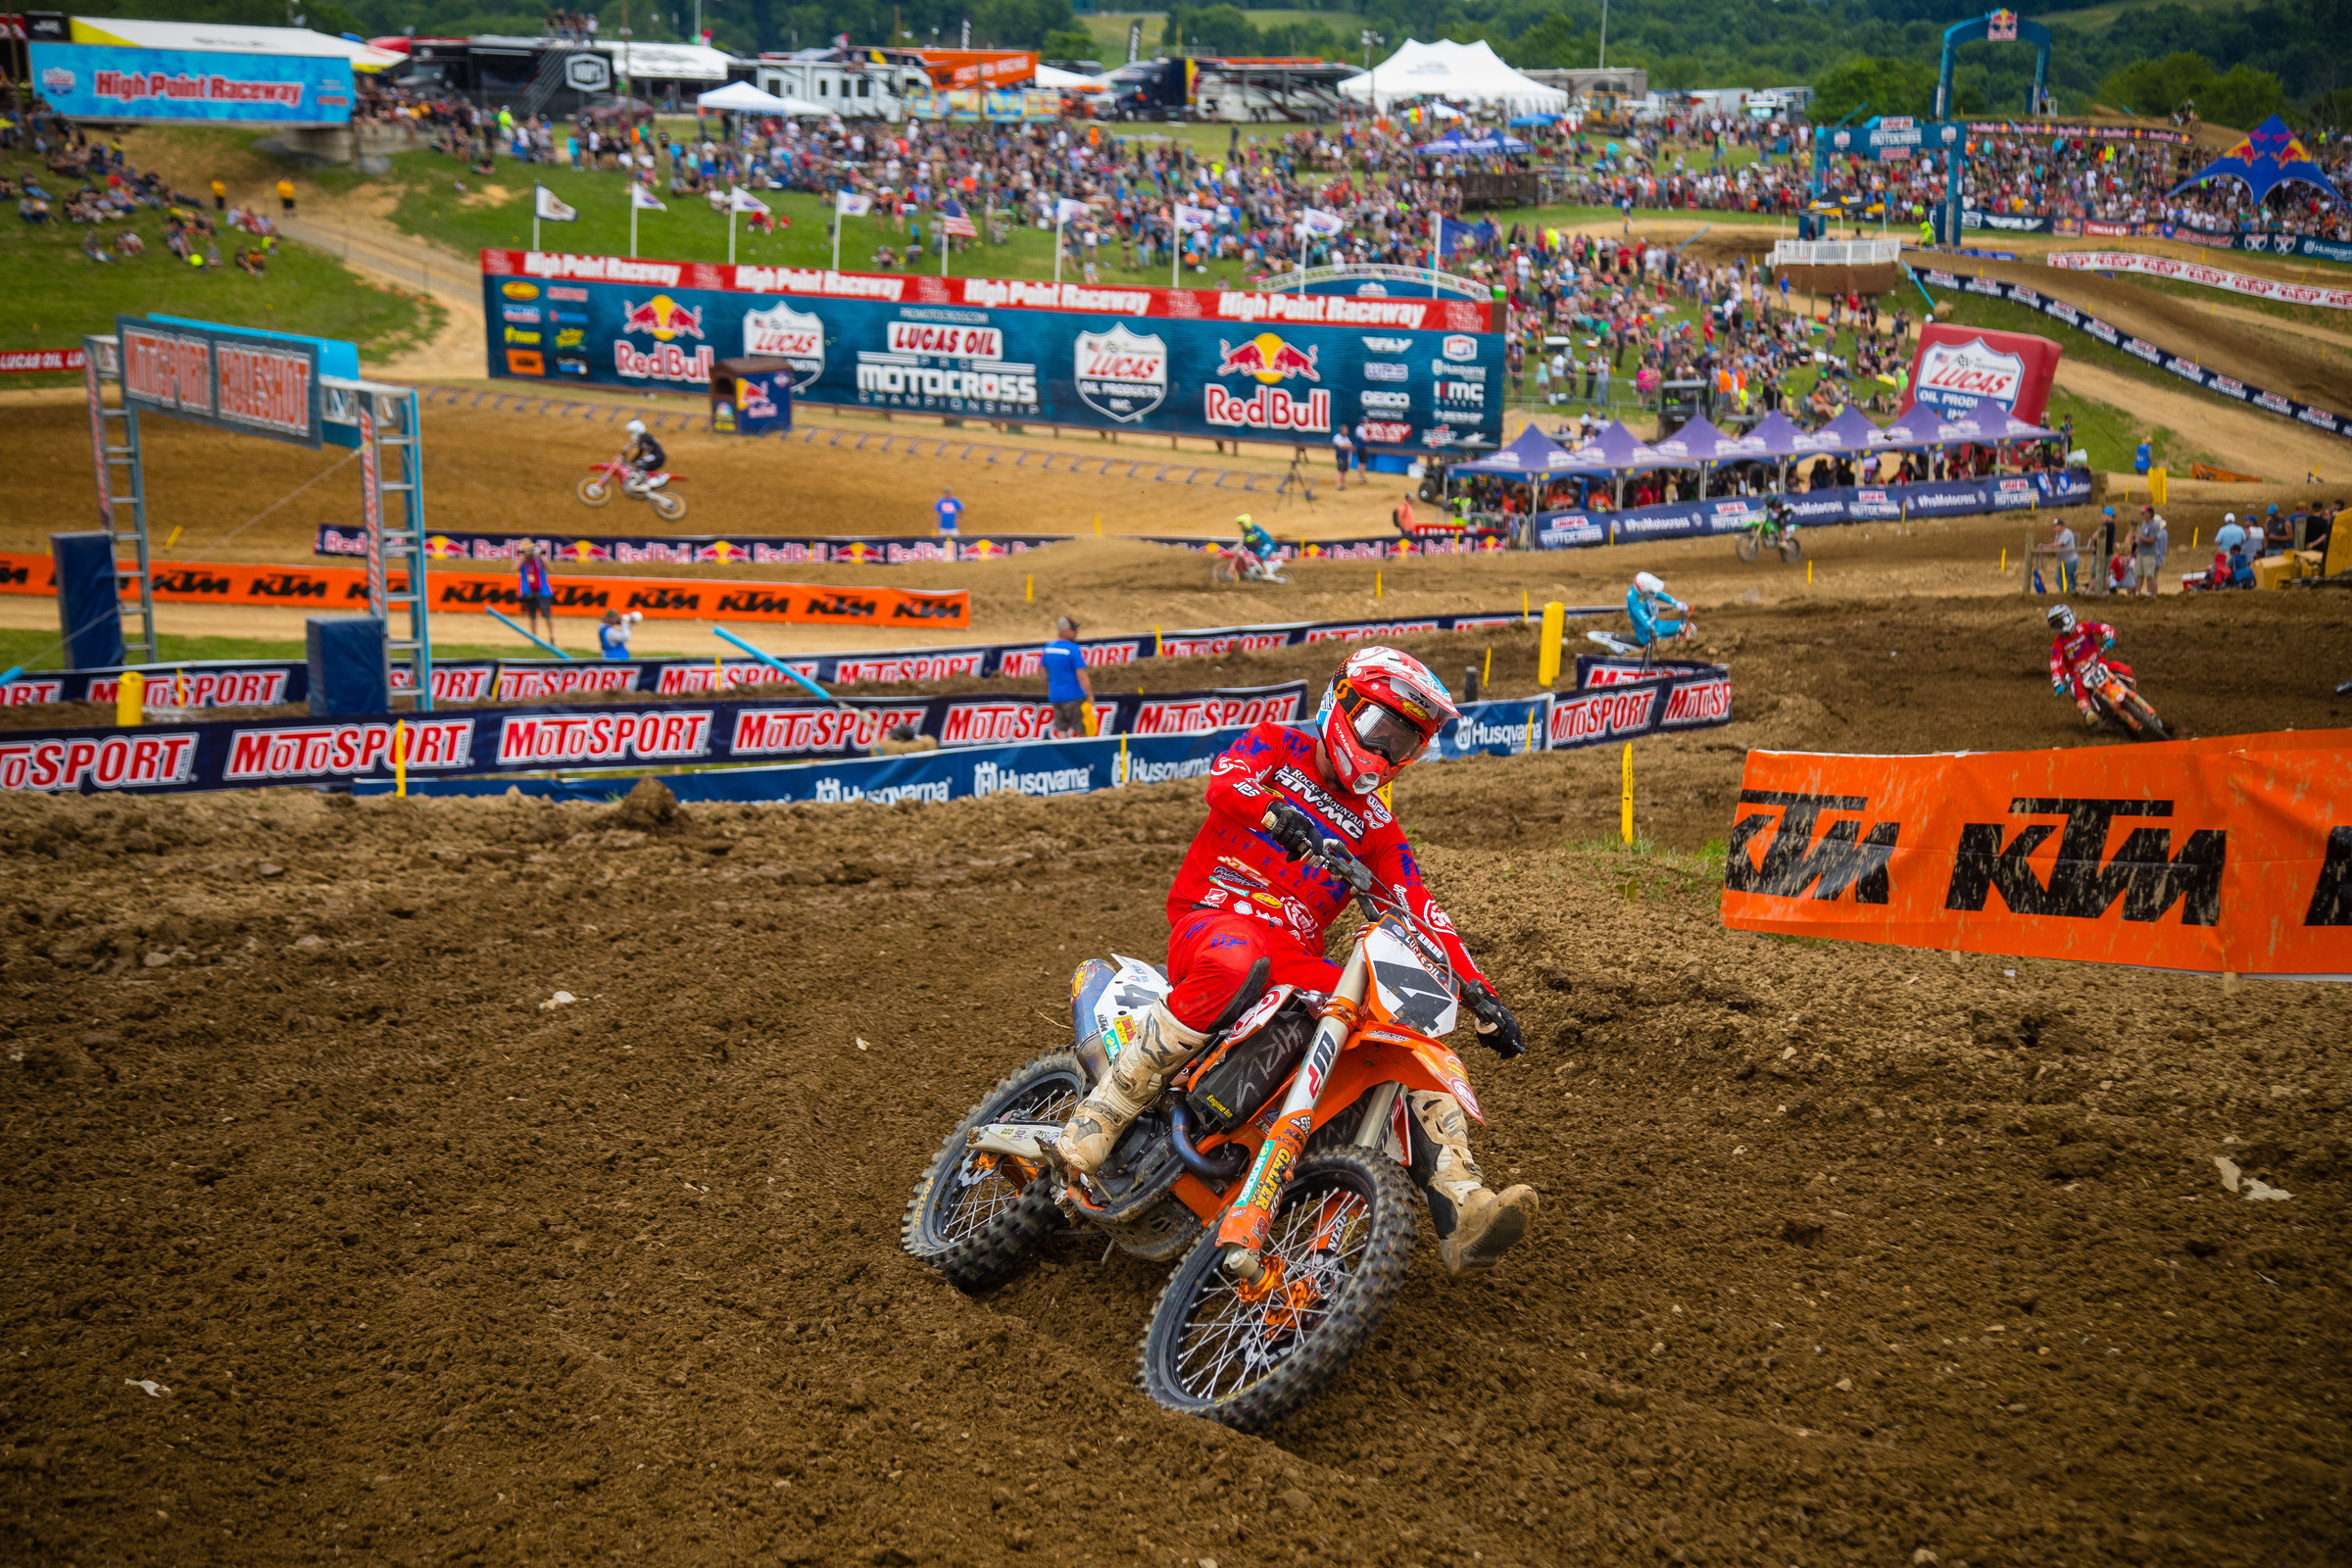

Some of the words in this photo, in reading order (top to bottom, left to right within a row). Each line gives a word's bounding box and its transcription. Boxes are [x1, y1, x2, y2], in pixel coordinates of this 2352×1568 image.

[94, 70, 146, 103] High
[149, 74, 207, 99] Point
[209, 74, 304, 108] Raceway
[524, 251, 562, 278] High
[564, 254, 605, 278] Point
[607, 257, 682, 287] Raceway
[735, 265, 775, 293] High
[777, 268, 823, 293] Point
[824, 270, 905, 302] Raceway
[963, 278, 1007, 308] High
[1009, 280, 1060, 309] Point
[1061, 284, 1152, 317] Raceway
[1218, 291, 1267, 321] High
[1268, 294, 1326, 320] Point
[1327, 296, 1427, 330] Raceway
[756, 332, 817, 355] LUCAS
[895, 326, 957, 352] LUCAS
[964, 329, 996, 355] OIL
[0, 354, 40, 369] LUCAS
[42, 354, 63, 368] OIL
[614, 339, 663, 378] Red
[664, 344, 715, 384] Bull
[1086, 355, 1159, 379] LUCAS
[857, 363, 1037, 405] MOTOCROSS
[1081, 380, 1101, 394] OIL
[1102, 382, 1161, 397] PRODUCTS
[1929, 367, 2012, 394] LUCAS
[858, 391, 1040, 416] CHAMPIONSHIP
[1204, 383, 1268, 427] Red
[1268, 387, 1331, 432] Bull
[1360, 390, 1410, 409] GEICO
[1919, 390, 1939, 404] OIL
[1918, 493, 1977, 509] #ProMotocross
[1625, 517, 1690, 533] #ProMotocross
[325, 530, 368, 554] Red
[473, 540, 513, 561] Red
[615, 542, 652, 564] Red
[653, 542, 693, 564] Bull
[754, 542, 792, 564] Red
[888, 542, 924, 563] Red
[153, 570, 229, 594] KTM
[249, 574, 327, 597] KTM
[442, 581, 524, 604] KTM
[626, 587, 701, 611] KTM
[716, 590, 790, 614] KTM
[806, 594, 878, 617] KTM
[892, 597, 961, 619] KTM
[502, 713, 709, 761] MOTOSPORT
[999, 766, 1091, 796] Husqvarna
[1132, 756, 1212, 782] Husqvarna
[1293, 767, 1322, 794] ROCKY
[1320, 790, 1365, 829] MOUNTAIN
[1366, 794, 1393, 824] WPS
[1945, 797, 2227, 927] KTM
[1114, 983, 1160, 1009] 4
[1206, 1094, 1225, 1114] Engine
[1224, 1109, 1234, 1119] Ice
[1283, 1128, 1305, 1151] KTM
[1238, 1156, 1267, 1202] MOTOREX
